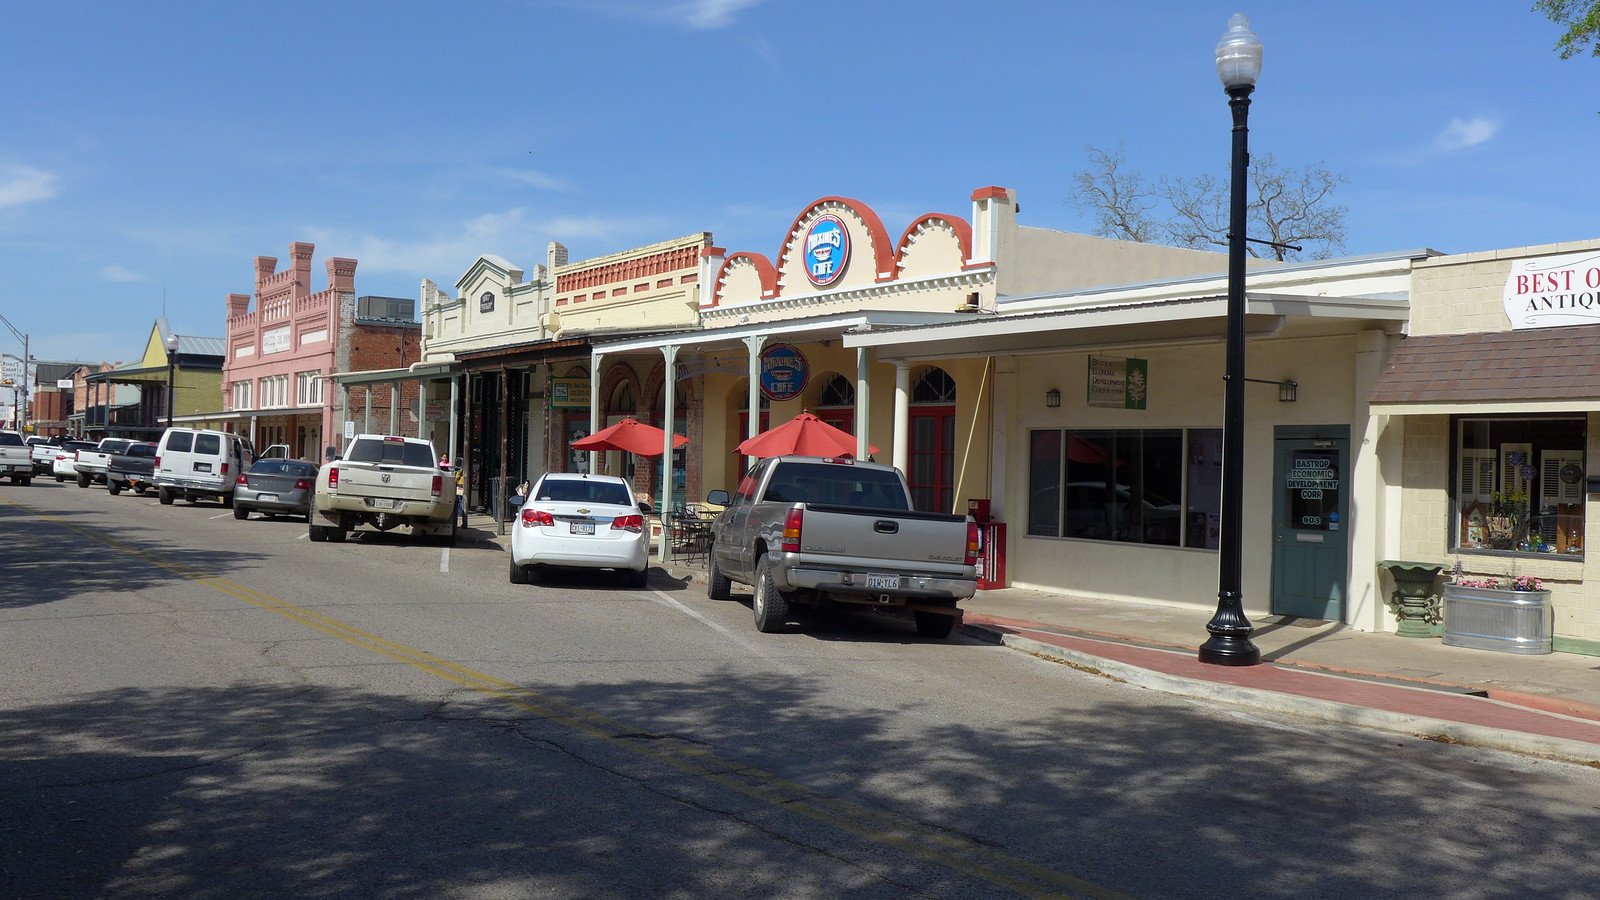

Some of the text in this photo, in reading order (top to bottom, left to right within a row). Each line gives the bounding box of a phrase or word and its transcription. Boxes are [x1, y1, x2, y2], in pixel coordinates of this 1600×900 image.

[808, 228, 841, 254] MAXINE'S
[813, 261, 833, 275] CAFE
[1516, 269, 1575, 295] BEST
[1525, 292, 1600, 311] ANTIQ
[1296, 459, 1330, 469] BASTROP
[1292, 469, 1334, 479] ECONOMIC
[1287, 480, 1338, 489] DEVELOPMENT
[1303, 516, 1320, 524] 903
